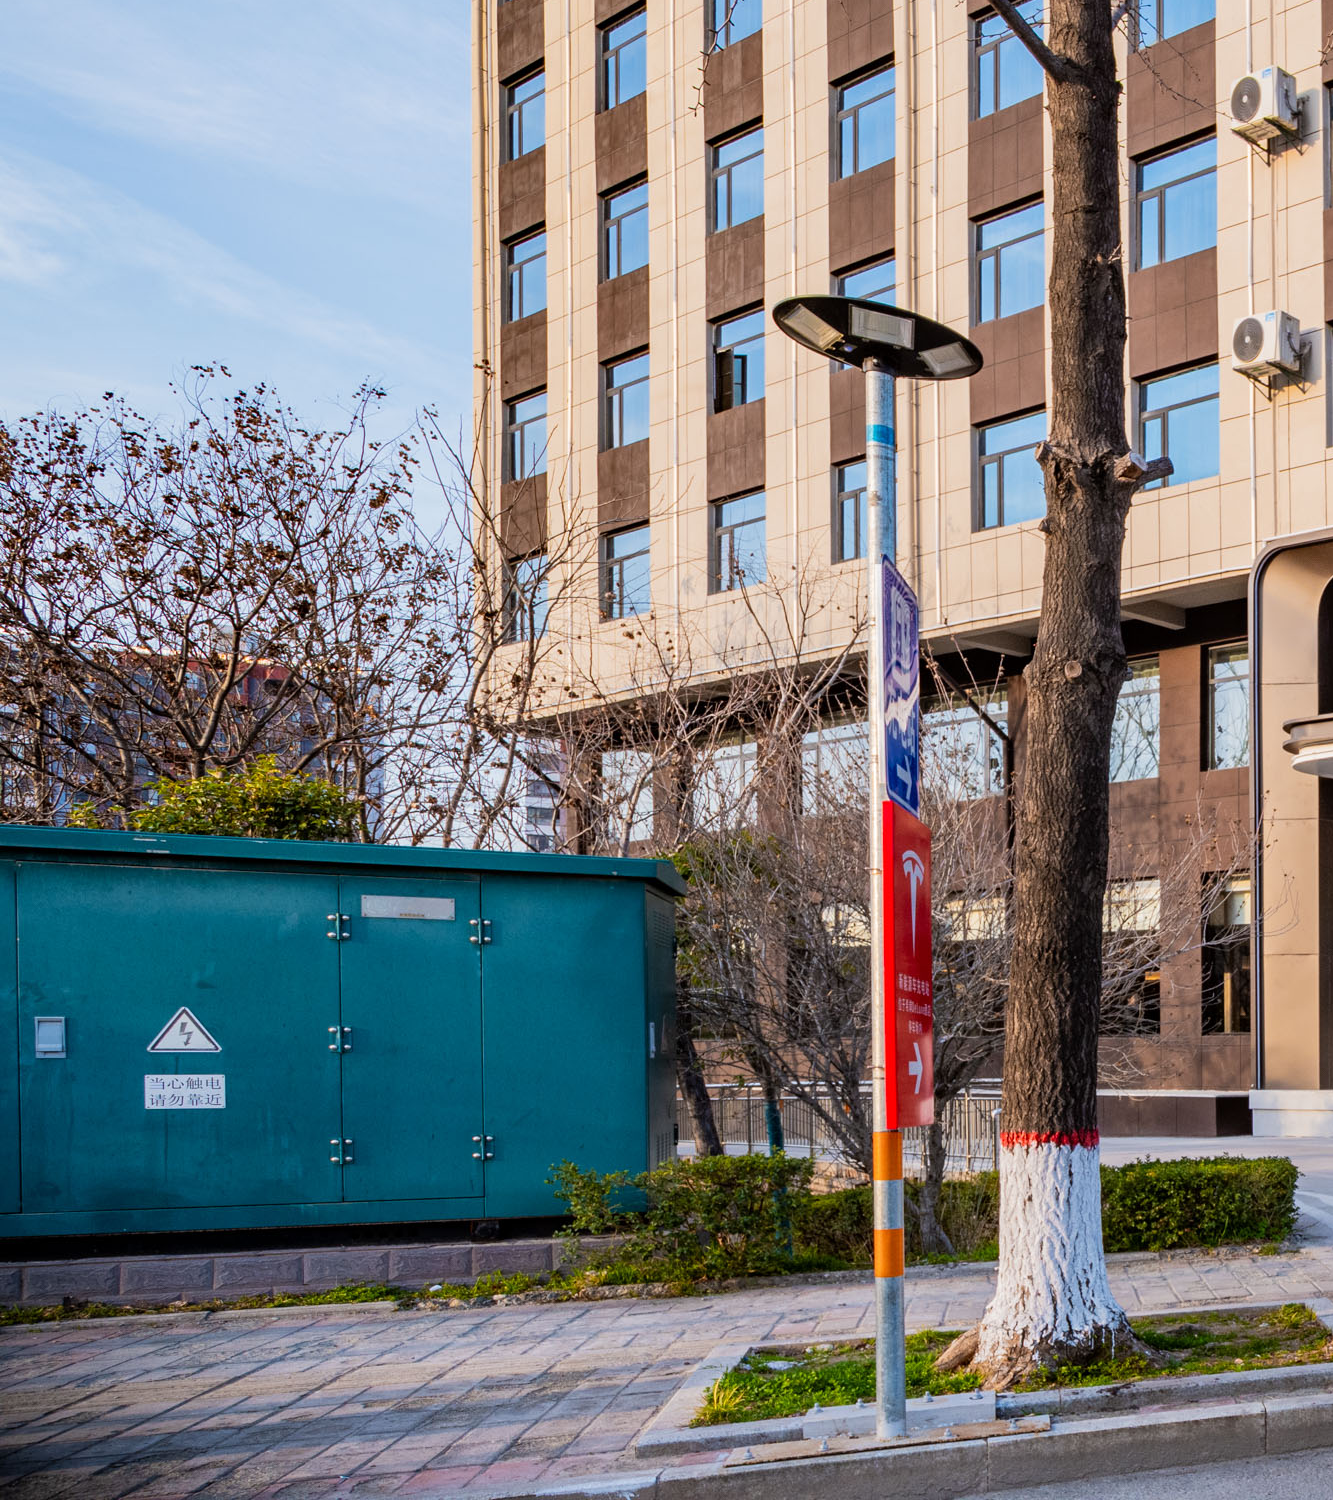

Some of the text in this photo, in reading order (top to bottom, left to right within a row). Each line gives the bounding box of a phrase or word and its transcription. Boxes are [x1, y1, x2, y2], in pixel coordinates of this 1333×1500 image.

[149, 1076, 222, 1090] 当心触电
[150, 1093, 223, 1107] 请勿靠近
